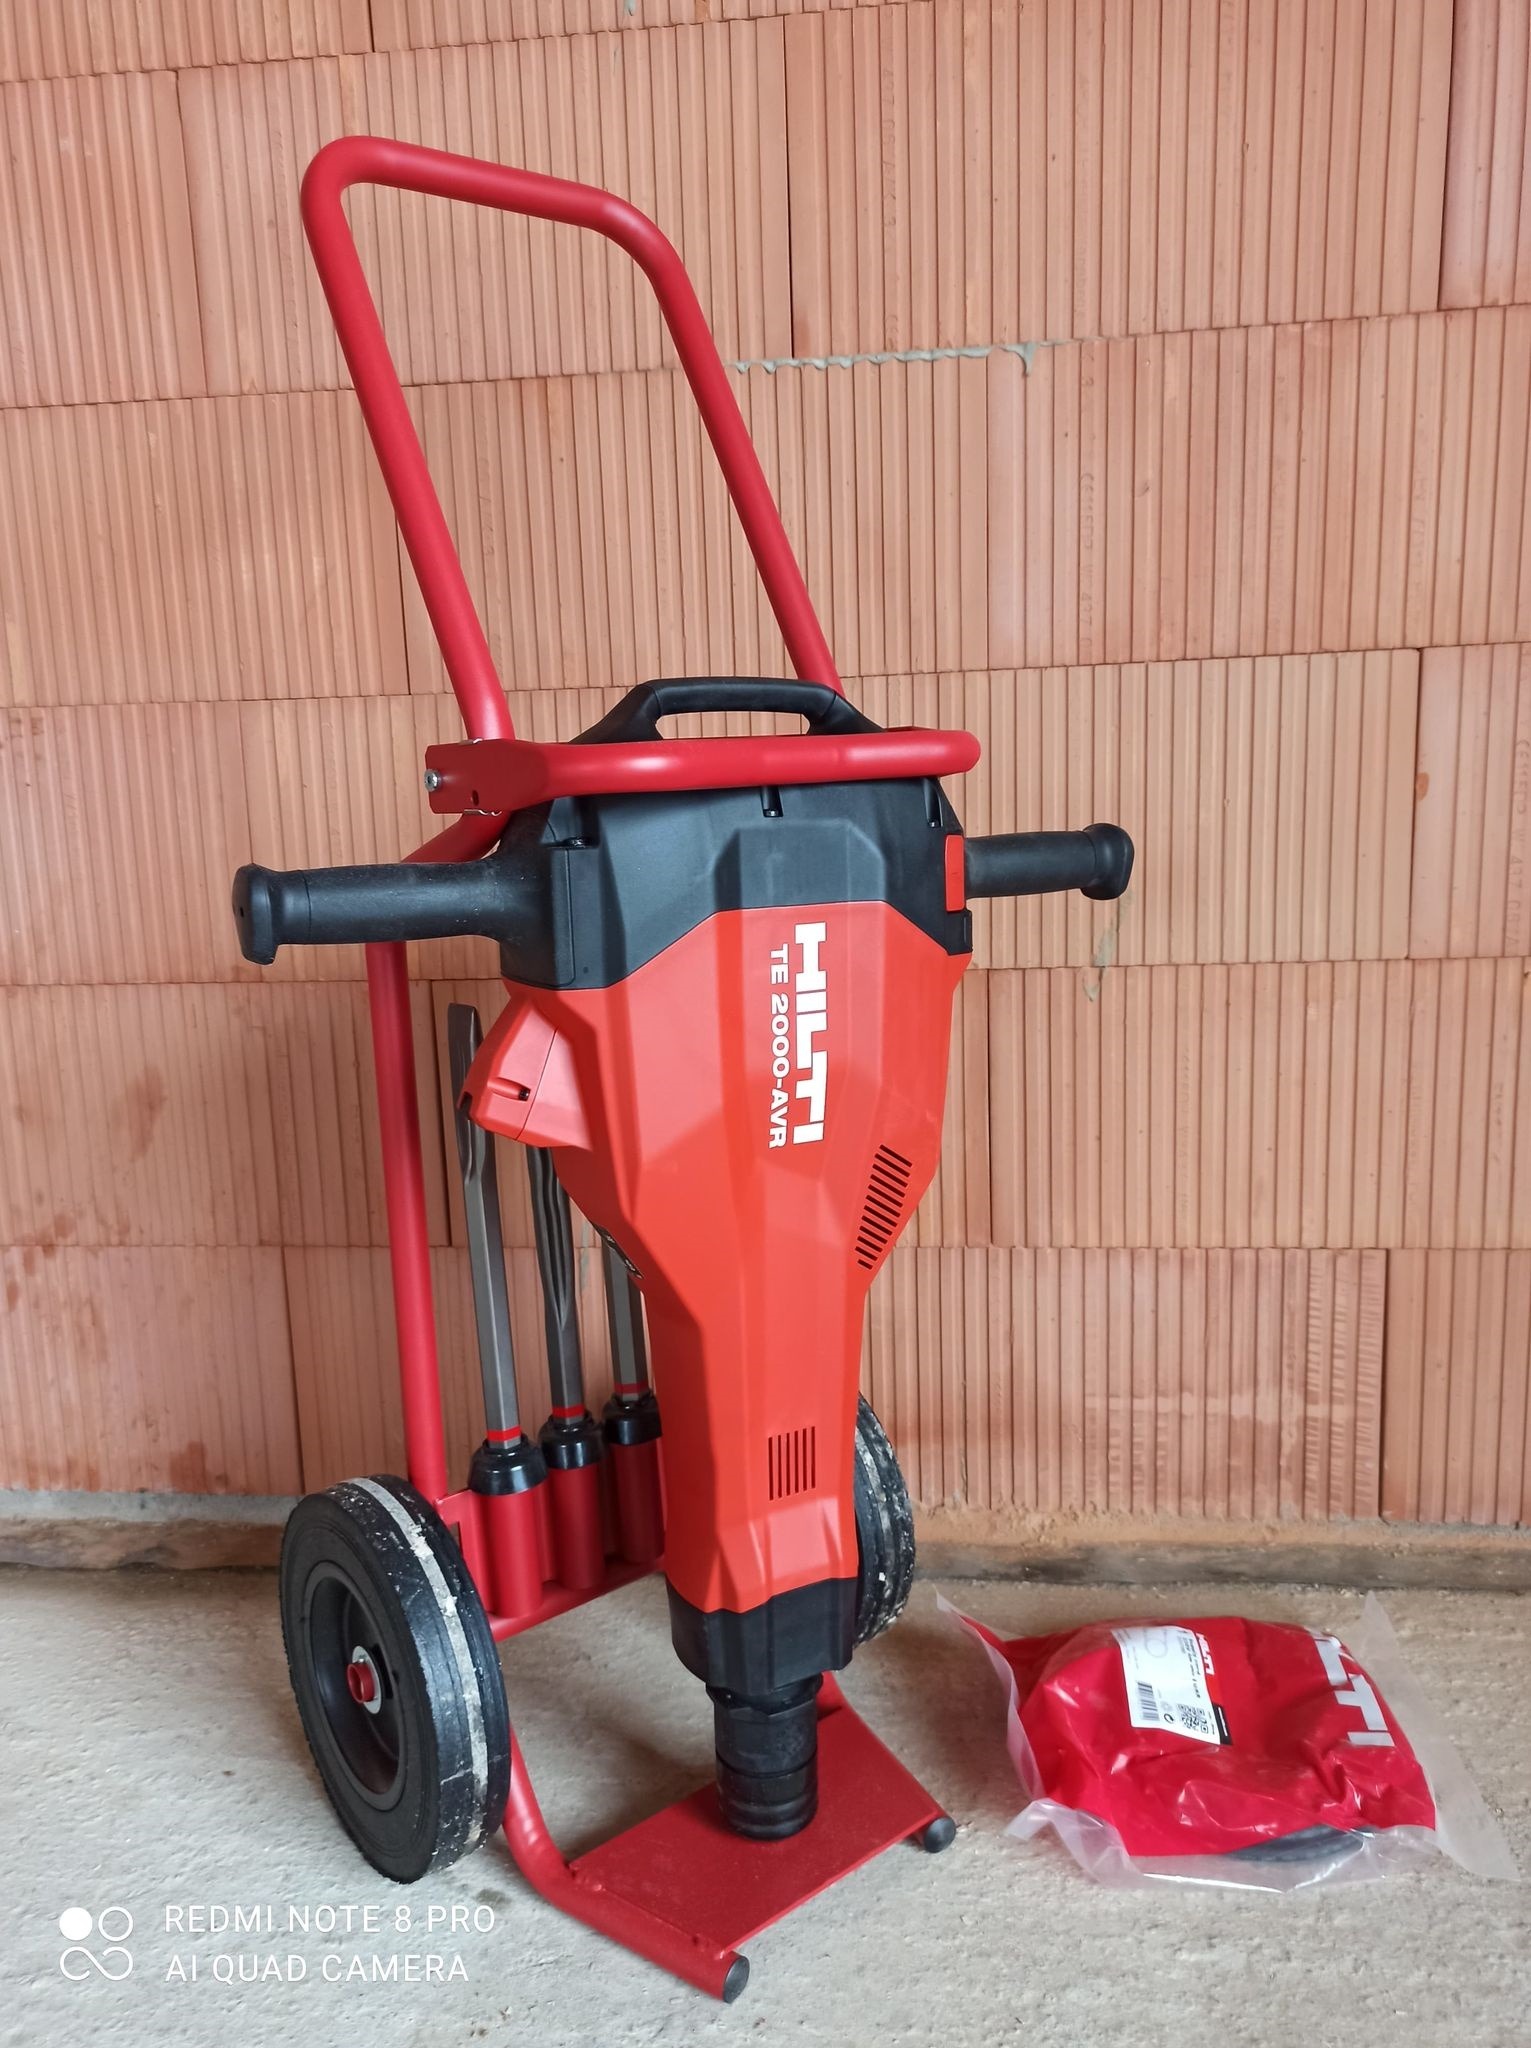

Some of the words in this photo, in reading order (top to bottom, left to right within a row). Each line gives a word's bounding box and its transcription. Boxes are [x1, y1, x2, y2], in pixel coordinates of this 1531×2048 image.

[769, 943, 790, 985] TE
[794, 921, 828, 1145] HILTI
[768, 992, 790, 1149] 2000-AVR
